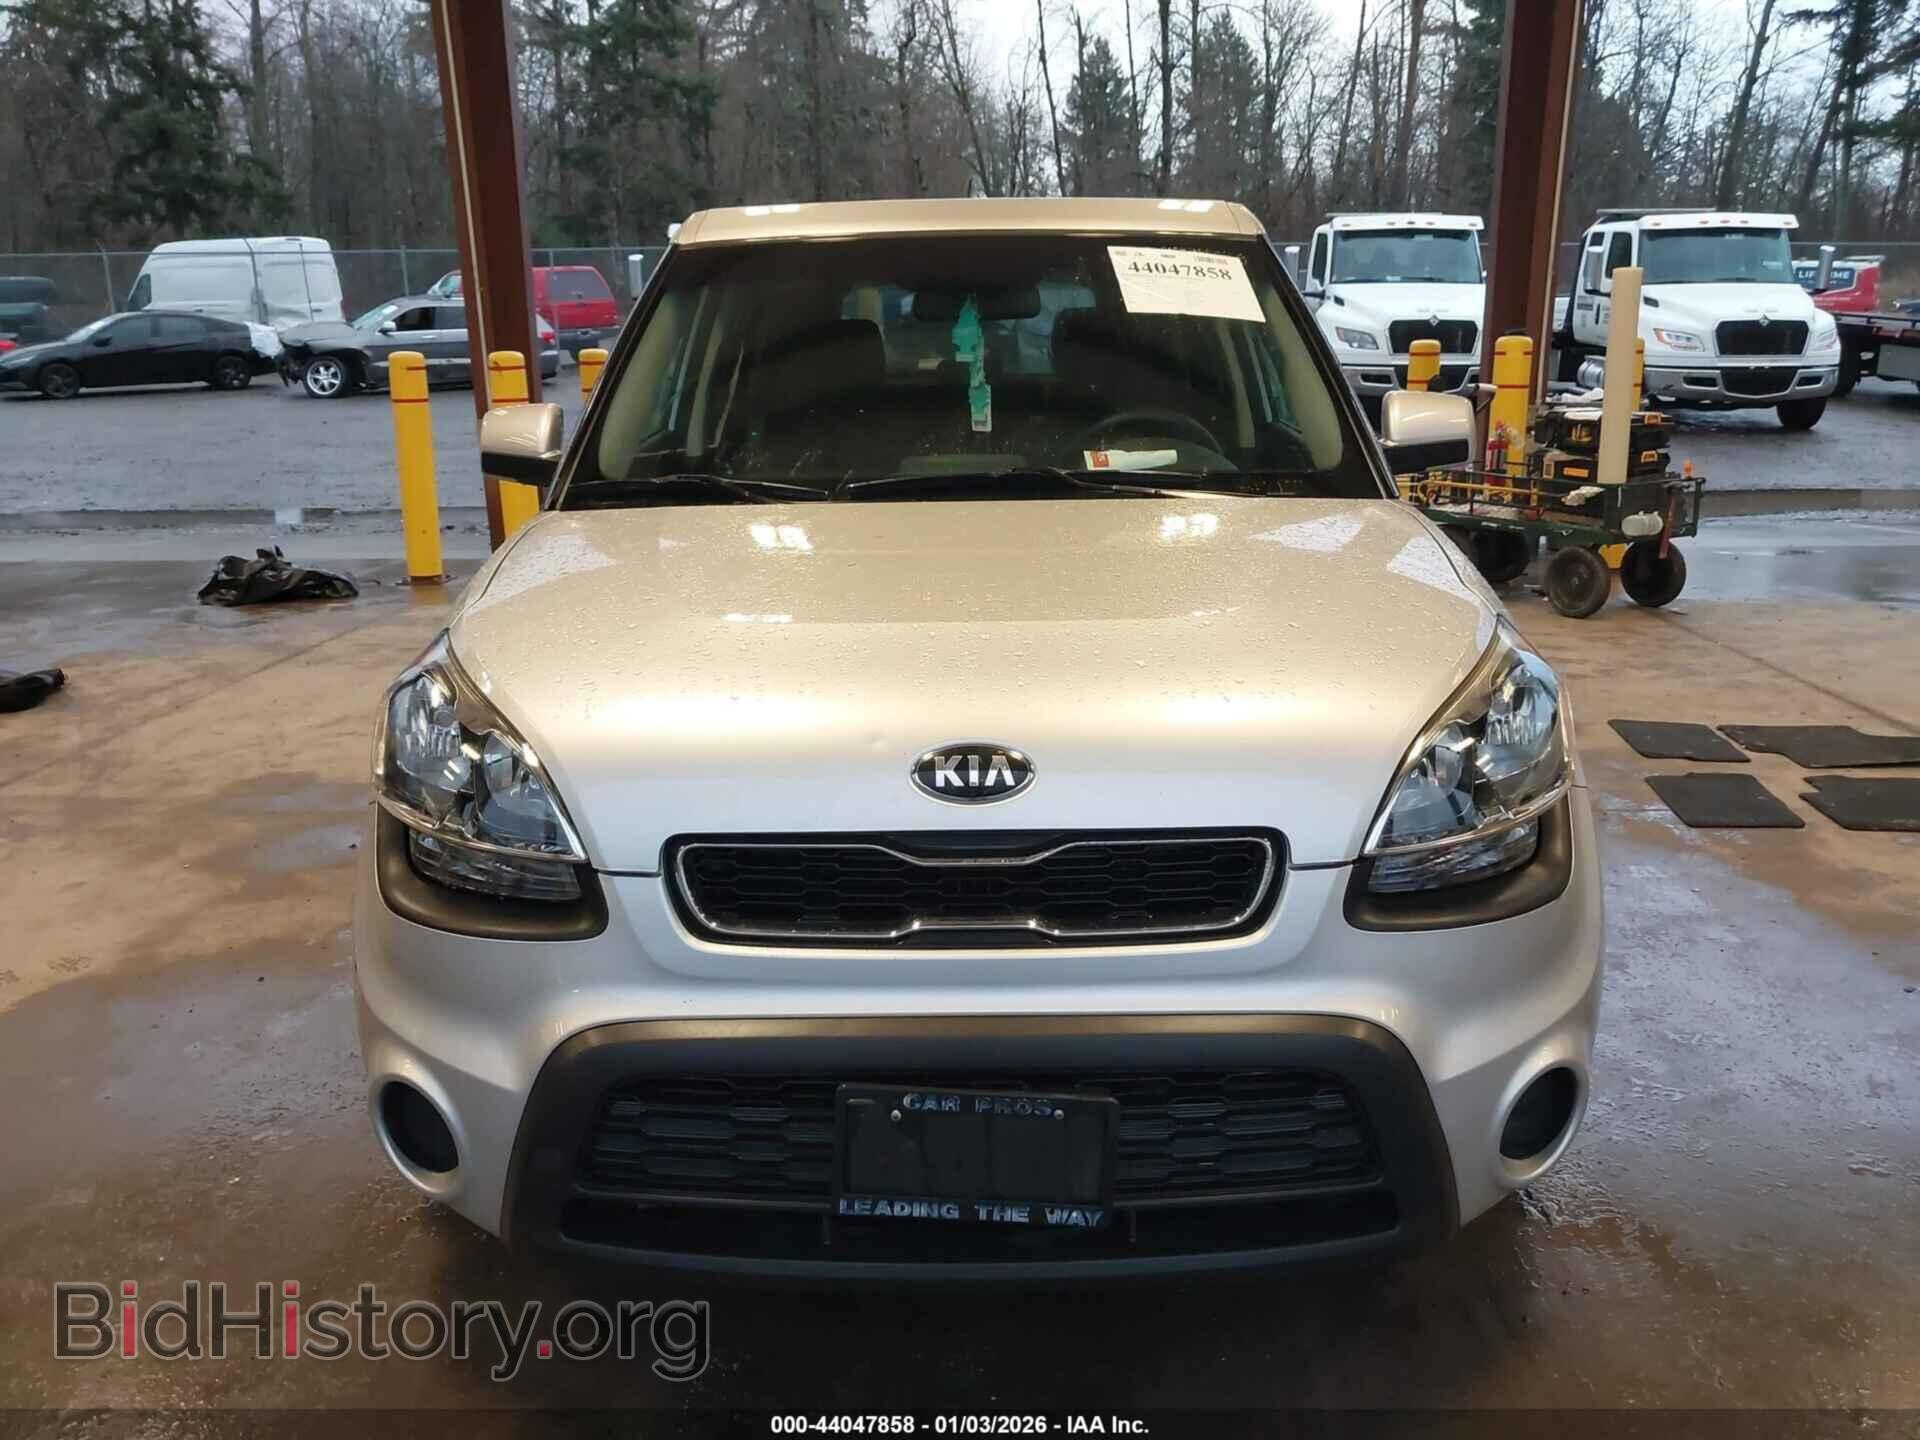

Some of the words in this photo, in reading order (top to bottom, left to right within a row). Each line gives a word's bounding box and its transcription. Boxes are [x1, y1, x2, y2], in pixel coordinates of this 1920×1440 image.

[1127, 261, 1233, 281] 44047858
[934, 754, 1016, 787] KIA
[903, 1092, 961, 1112] CAR
[974, 1096, 1052, 1116] PROS
[839, 1198, 960, 1220] LEADING
[974, 1204, 1030, 1223] THE
[1044, 1207, 1104, 1227] WAY
